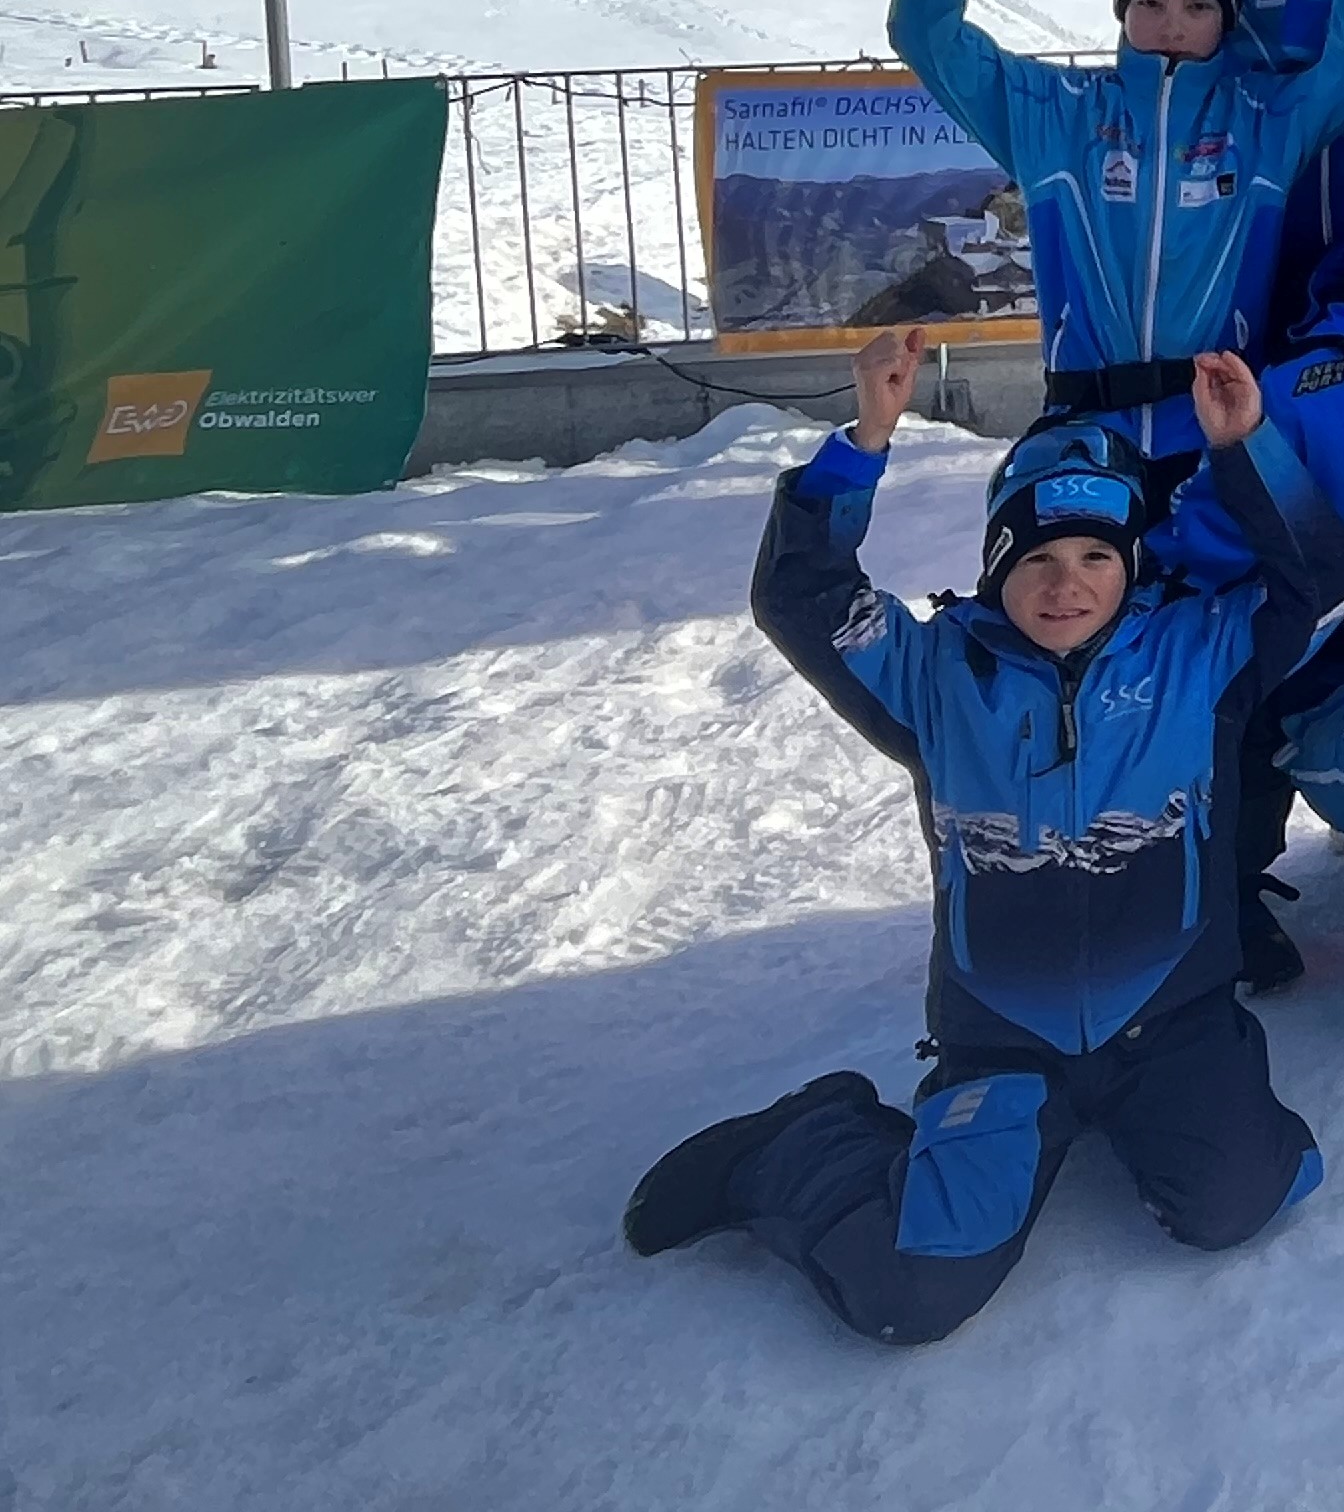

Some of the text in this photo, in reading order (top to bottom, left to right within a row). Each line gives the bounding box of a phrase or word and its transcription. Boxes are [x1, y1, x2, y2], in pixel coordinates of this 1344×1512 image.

[725, 129, 815, 151] HALTEN
[823, 126, 893, 148] DICHT
[901, 126, 926, 146] IN
[199, 410, 322, 430] Obwalden
[1052, 476, 1101, 497] SSC
[1101, 677, 1152, 713] SSC
